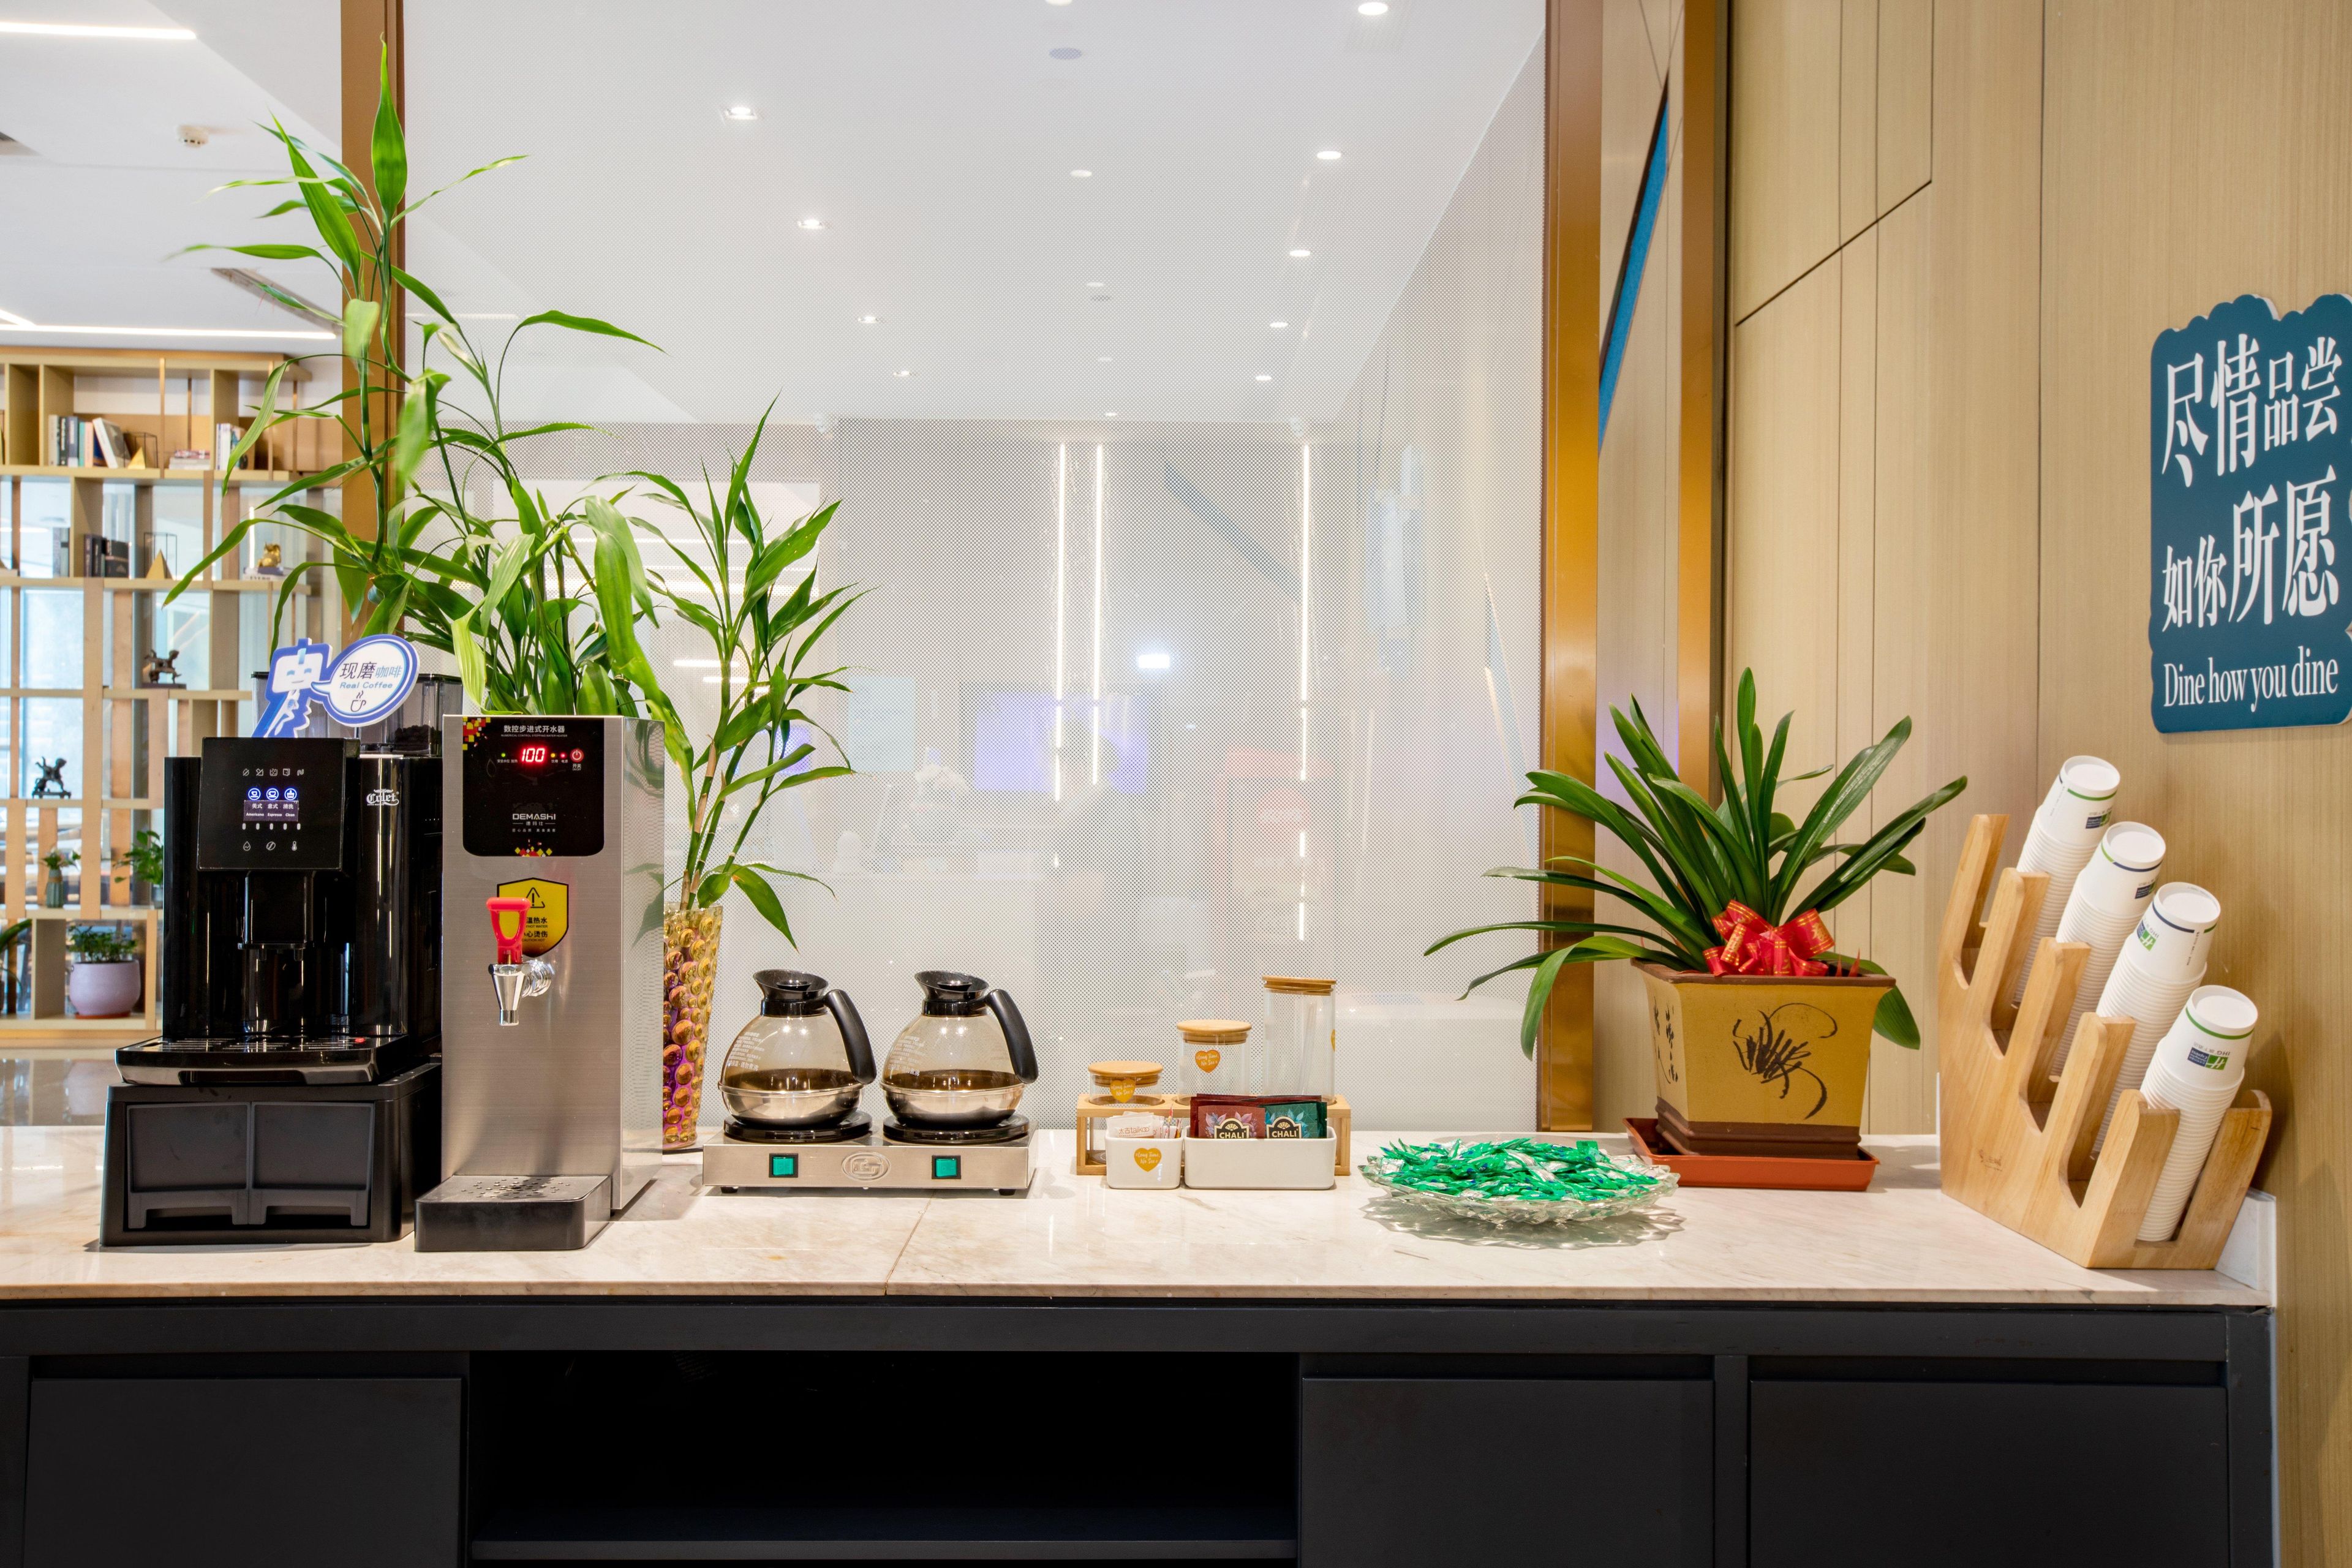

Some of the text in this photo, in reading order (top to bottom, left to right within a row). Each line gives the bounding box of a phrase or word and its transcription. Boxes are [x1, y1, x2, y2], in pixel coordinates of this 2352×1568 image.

[2162, 333, 2342, 488] 尽情品尝
[2162, 464, 2340, 632] 如你所愿
[339, 661, 402, 680] 现磨咖啡
[2163, 646, 2339, 712] Dine how you dine
[522, 748, 545, 762] 100
